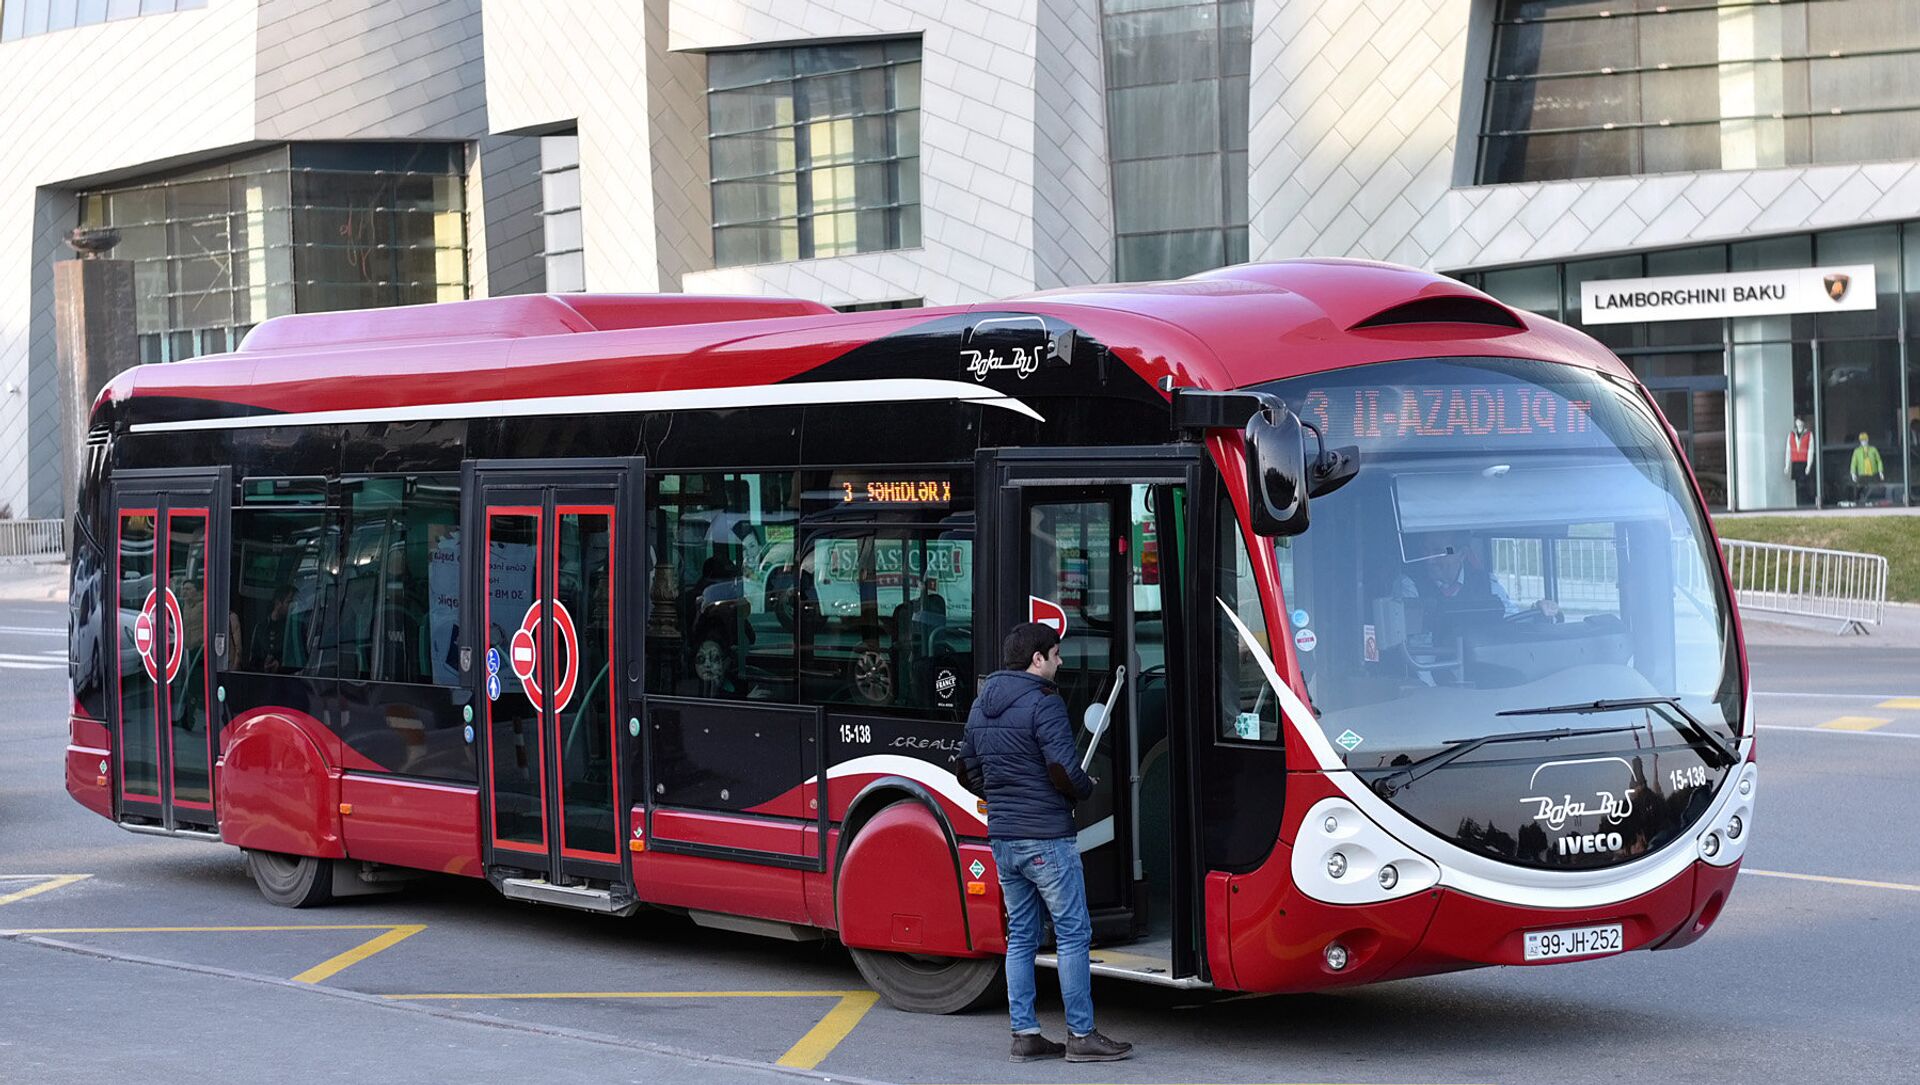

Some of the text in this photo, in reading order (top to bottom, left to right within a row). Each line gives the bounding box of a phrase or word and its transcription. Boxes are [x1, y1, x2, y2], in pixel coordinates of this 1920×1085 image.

[1594, 284, 1786, 310] LAMBORGHINI BAKU
[960, 346, 1044, 375] Baku Bus
[1305, 391, 1329, 438] 3
[842, 481, 853, 502] 3
[839, 724, 872, 744] 15-138
[1669, 765, 1707, 791] 15-138
[1520, 789, 1636, 824] Baku Bus
[1558, 832, 1623, 856] IVECO
[1541, 928, 1620, 956] 99-JH-252
